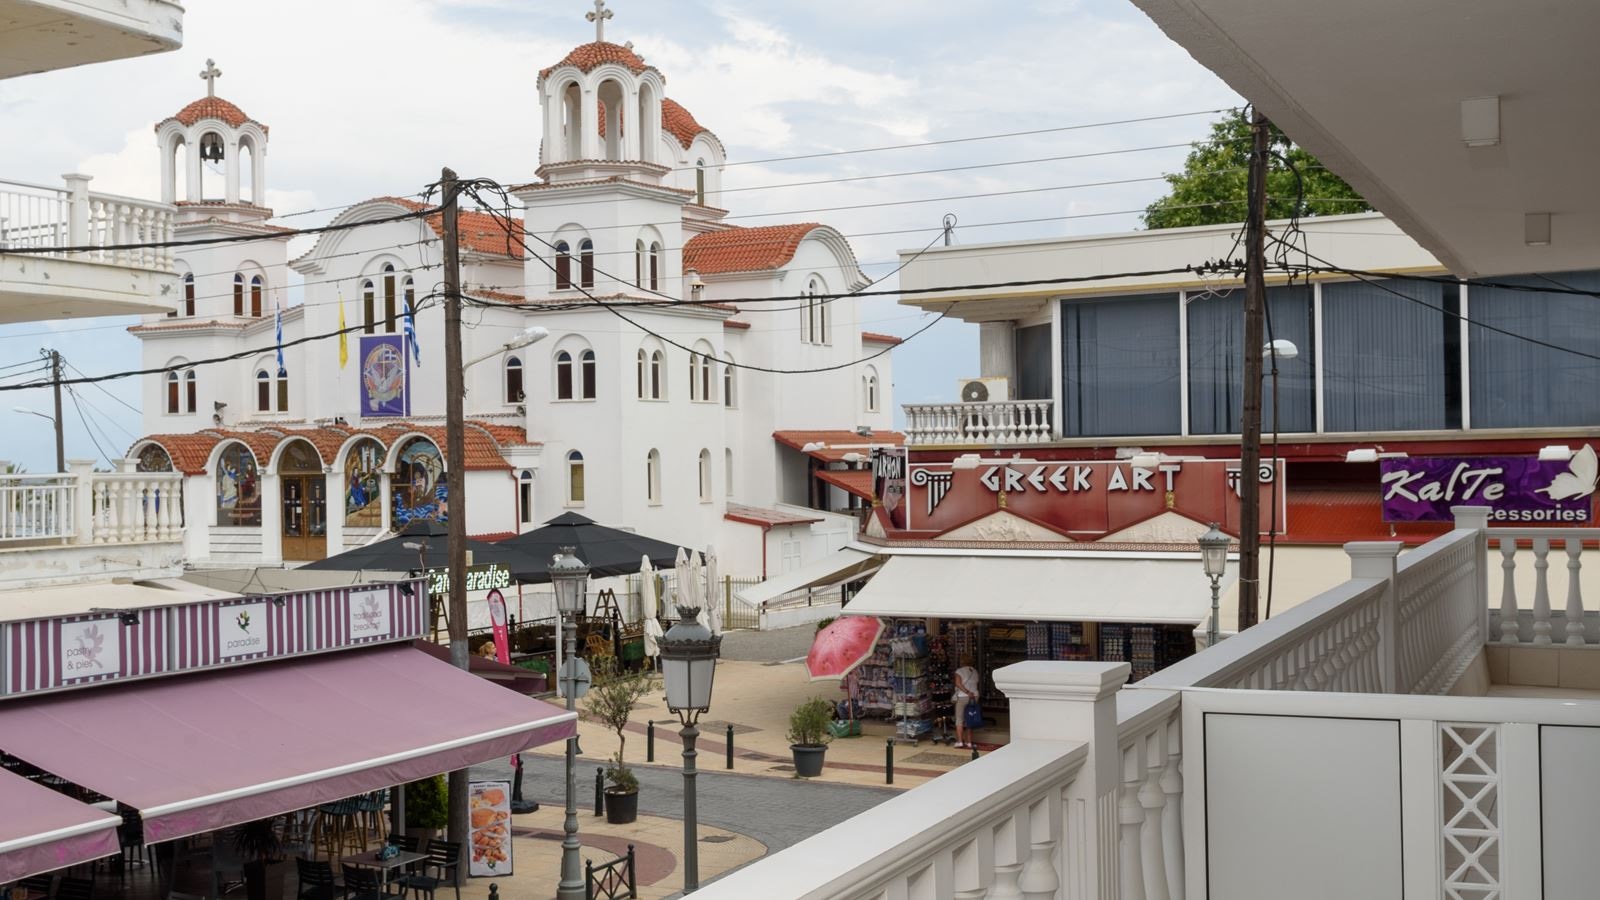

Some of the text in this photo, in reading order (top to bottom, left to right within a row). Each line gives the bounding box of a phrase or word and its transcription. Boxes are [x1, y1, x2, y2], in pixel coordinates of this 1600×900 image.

[980, 465, 1181, 491] GREEK ART
[1381, 462, 1505, 502] KalTe
[1487, 504, 1588, 521] cessories
[428, 564, 510, 594] Caf aradise
[227, 637, 261, 649] paradise
[66, 647, 92, 660] pastry
[66, 659, 94, 671] & pies
